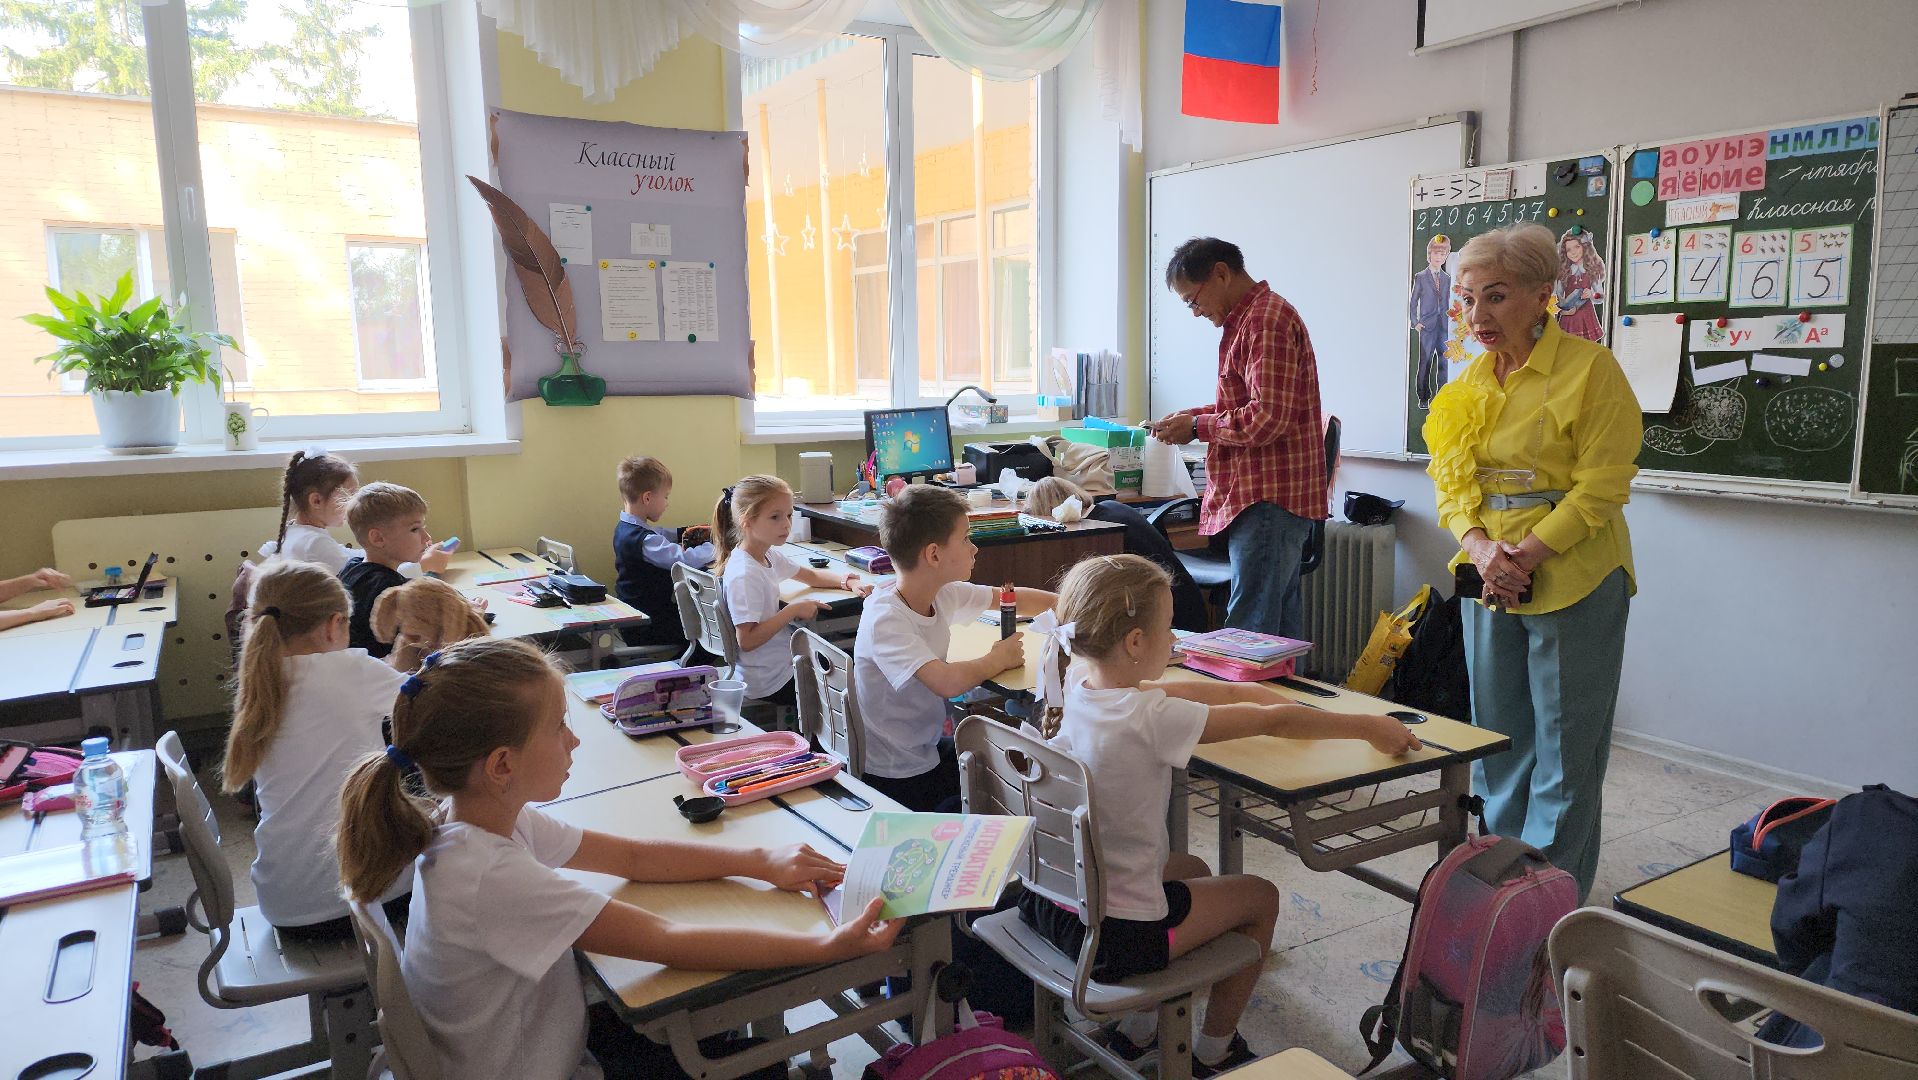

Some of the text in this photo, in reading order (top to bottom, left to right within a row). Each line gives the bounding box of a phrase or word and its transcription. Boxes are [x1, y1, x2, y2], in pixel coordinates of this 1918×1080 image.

[576, 141, 676, 171] Классный
[630, 173, 695, 196] уголок
[1747, 196, 1855, 221] Классная
[1633, 238, 1643, 255] 2
[1684, 233, 1697, 250] 4
[1741, 235, 1753, 253] 6
[1800, 233, 1812, 251] 5
[1647, 259, 1668, 296] 2
[1690, 255, 1722, 294] 4
[1751, 259, 1781, 299] 6
[1807, 257, 1843, 299] 5
[953, 819, 1007, 899] МАТЕМАТИКА
